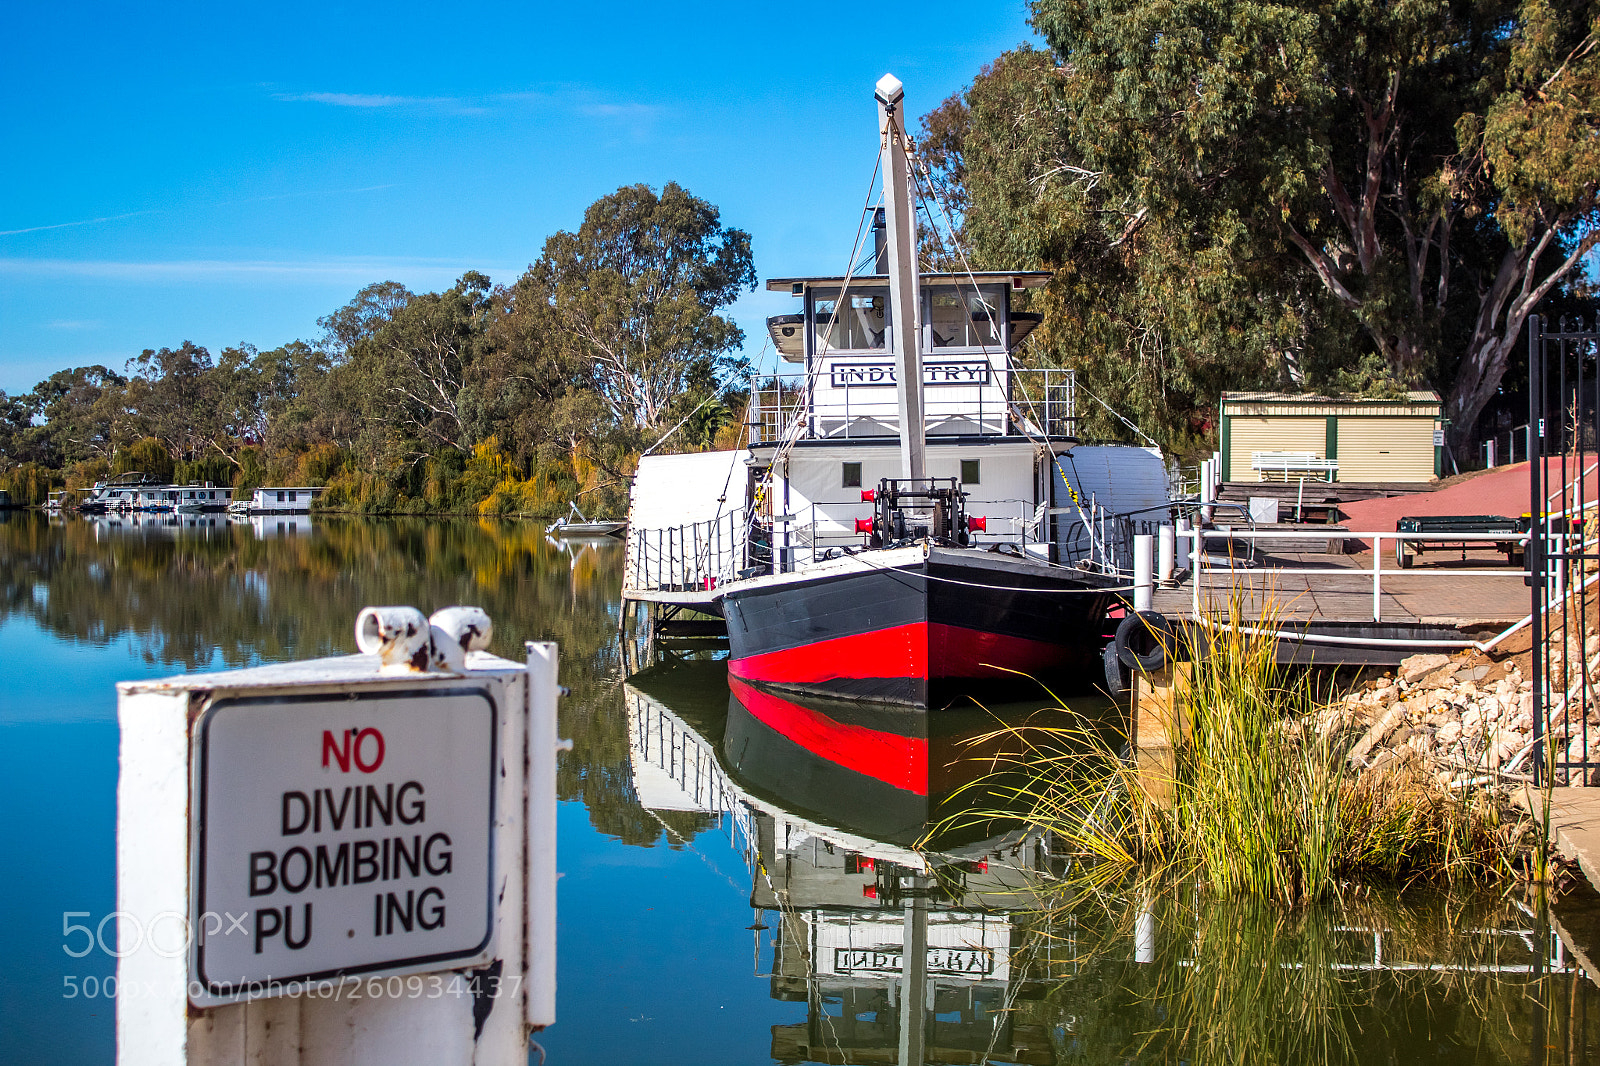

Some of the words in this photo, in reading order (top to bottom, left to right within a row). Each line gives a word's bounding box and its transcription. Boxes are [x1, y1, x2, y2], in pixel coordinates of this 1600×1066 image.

[839, 365, 981, 382] INDTRY
[321, 727, 386, 774] NO
[281, 780, 426, 837] DIVING
[249, 832, 453, 898] BOMBING
